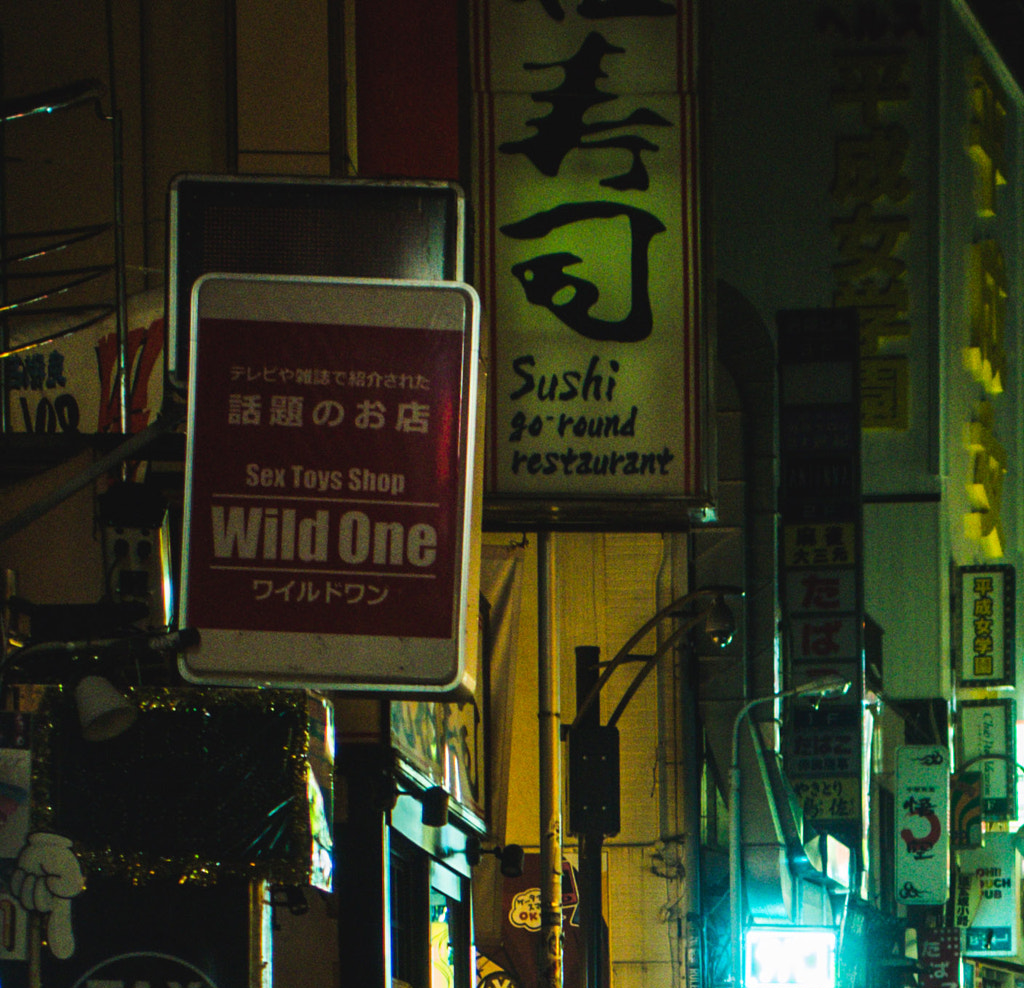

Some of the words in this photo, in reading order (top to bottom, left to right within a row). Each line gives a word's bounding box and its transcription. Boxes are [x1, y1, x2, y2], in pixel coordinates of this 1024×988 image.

[498, 0, 677, 343] 寿司
[229, 366, 431, 391] テレビや雑誌で紹介された
[509, 355, 620, 402] Sushi
[227, 394, 431, 434] 話題のお店
[509, 405, 637, 442] go-round
[245, 463, 286, 487] Sex
[291, 465, 343, 492] Toys
[347, 468, 406, 496] Shop
[511, 447, 674, 476] restaurant
[210, 505, 329, 563] Wild
[338, 510, 438, 567] One
[252, 579, 390, 606] ワイルドワン
[973, 577, 994, 676] 平成女学園
